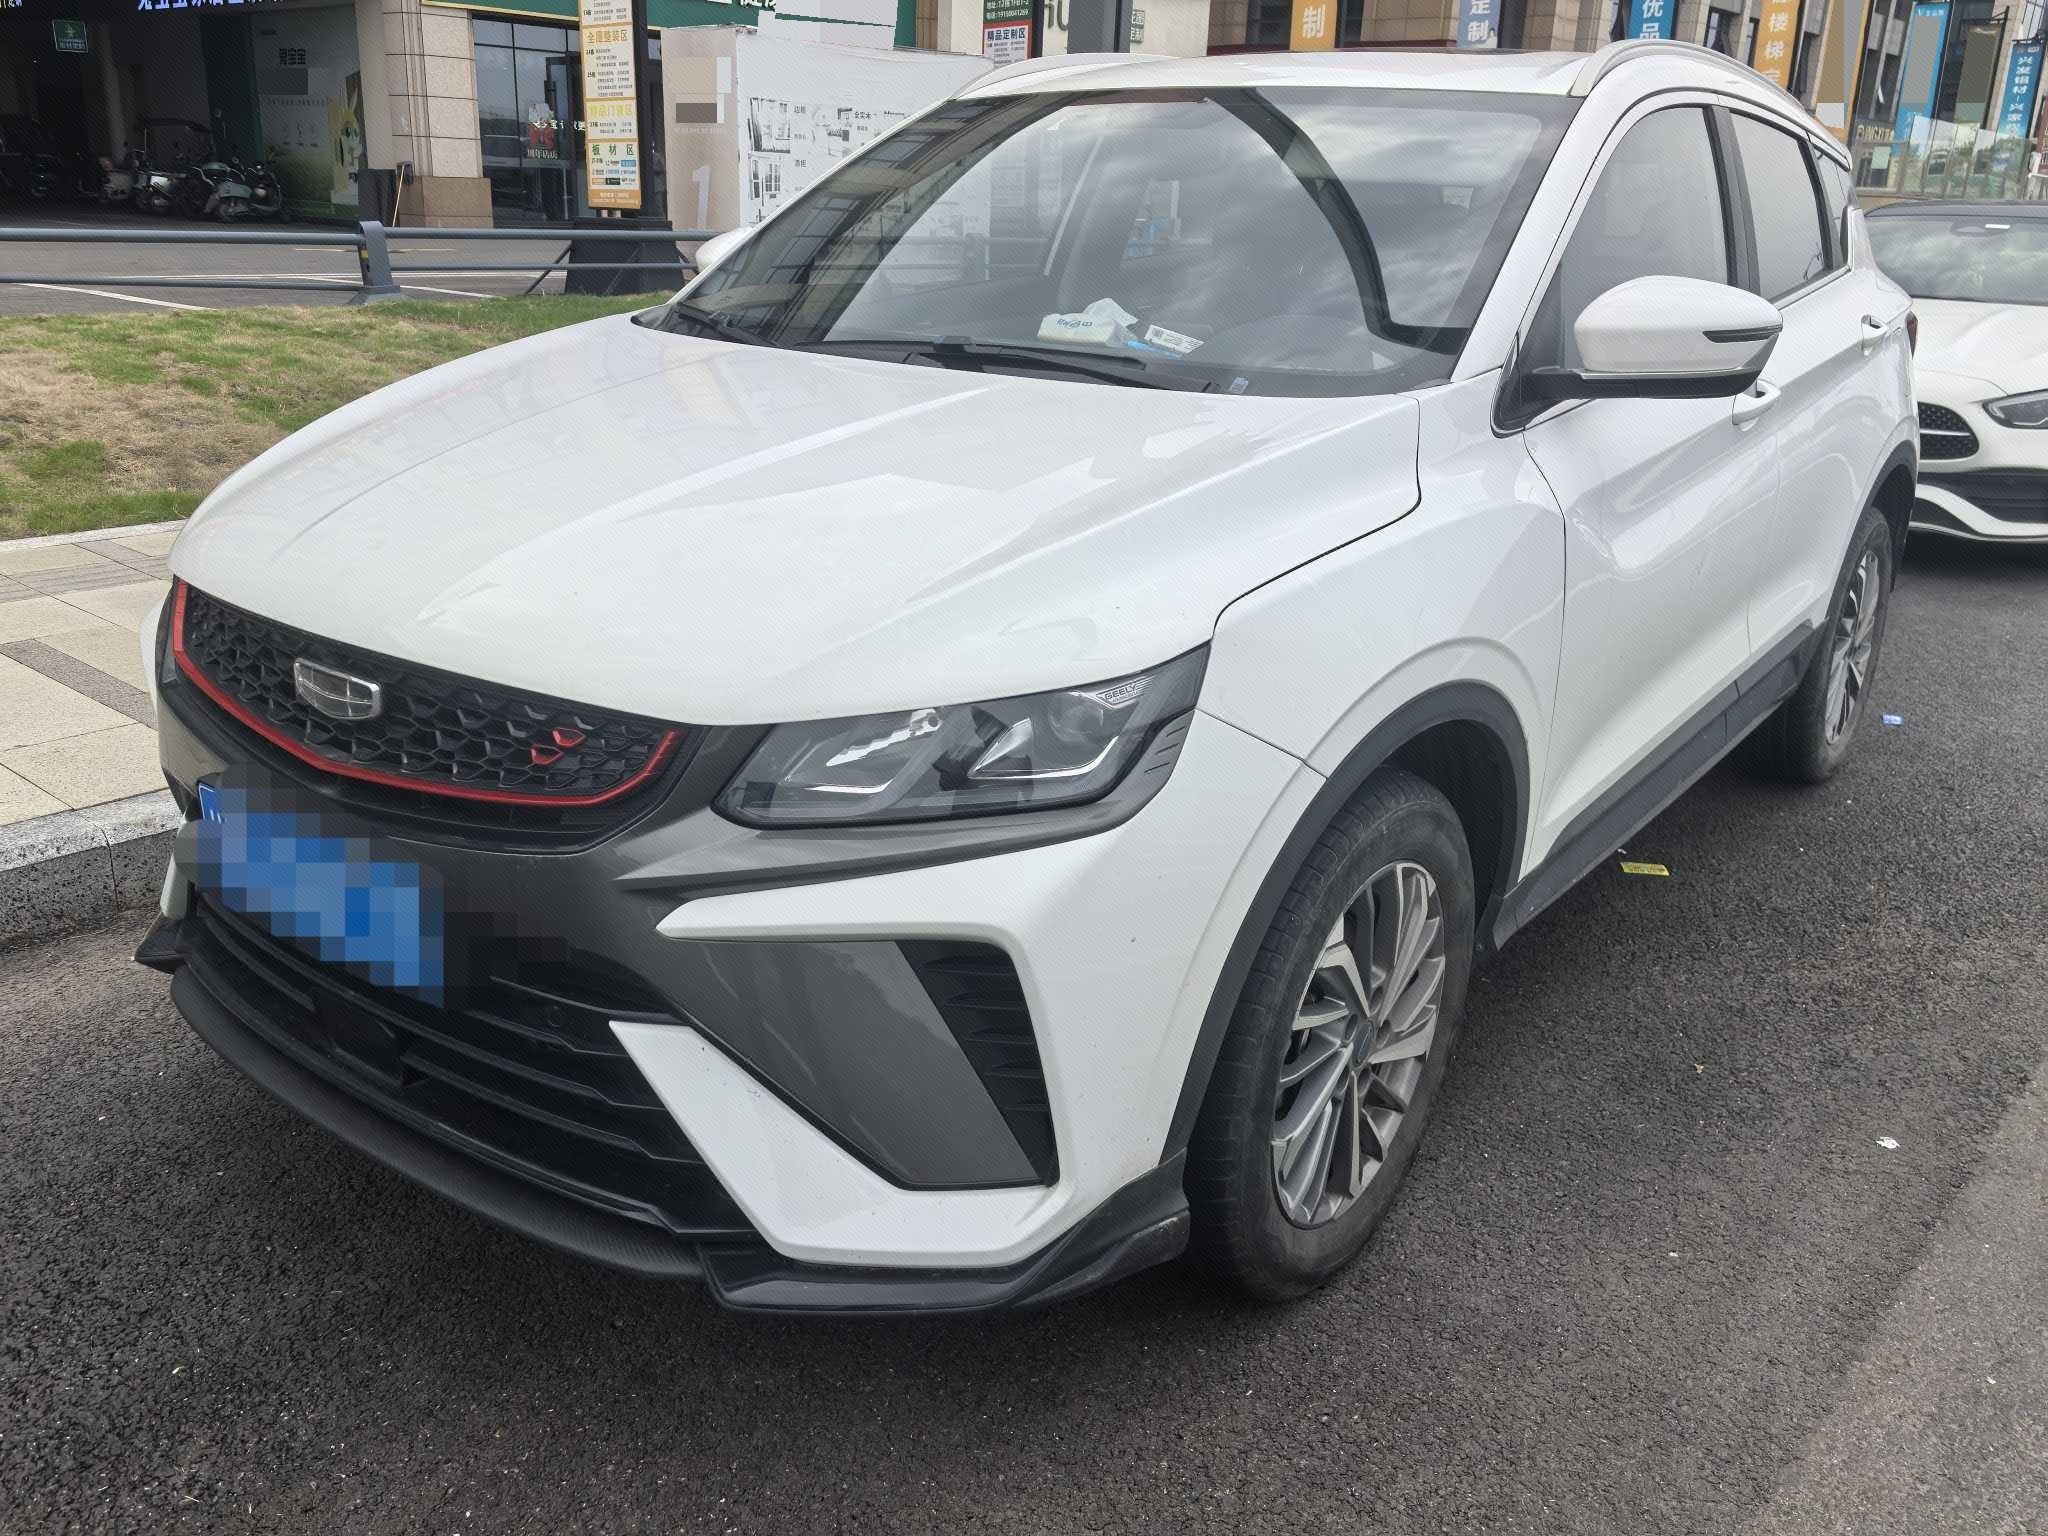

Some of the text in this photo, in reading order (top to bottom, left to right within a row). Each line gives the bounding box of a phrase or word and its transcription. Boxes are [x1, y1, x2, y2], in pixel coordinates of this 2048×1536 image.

[1302, 4, 1326, 39] 制
[1640, 0, 1664, 40] 优品
[987, 27, 1026, 41] 精品定制区
[1104, 683, 1138, 700] GEELY
